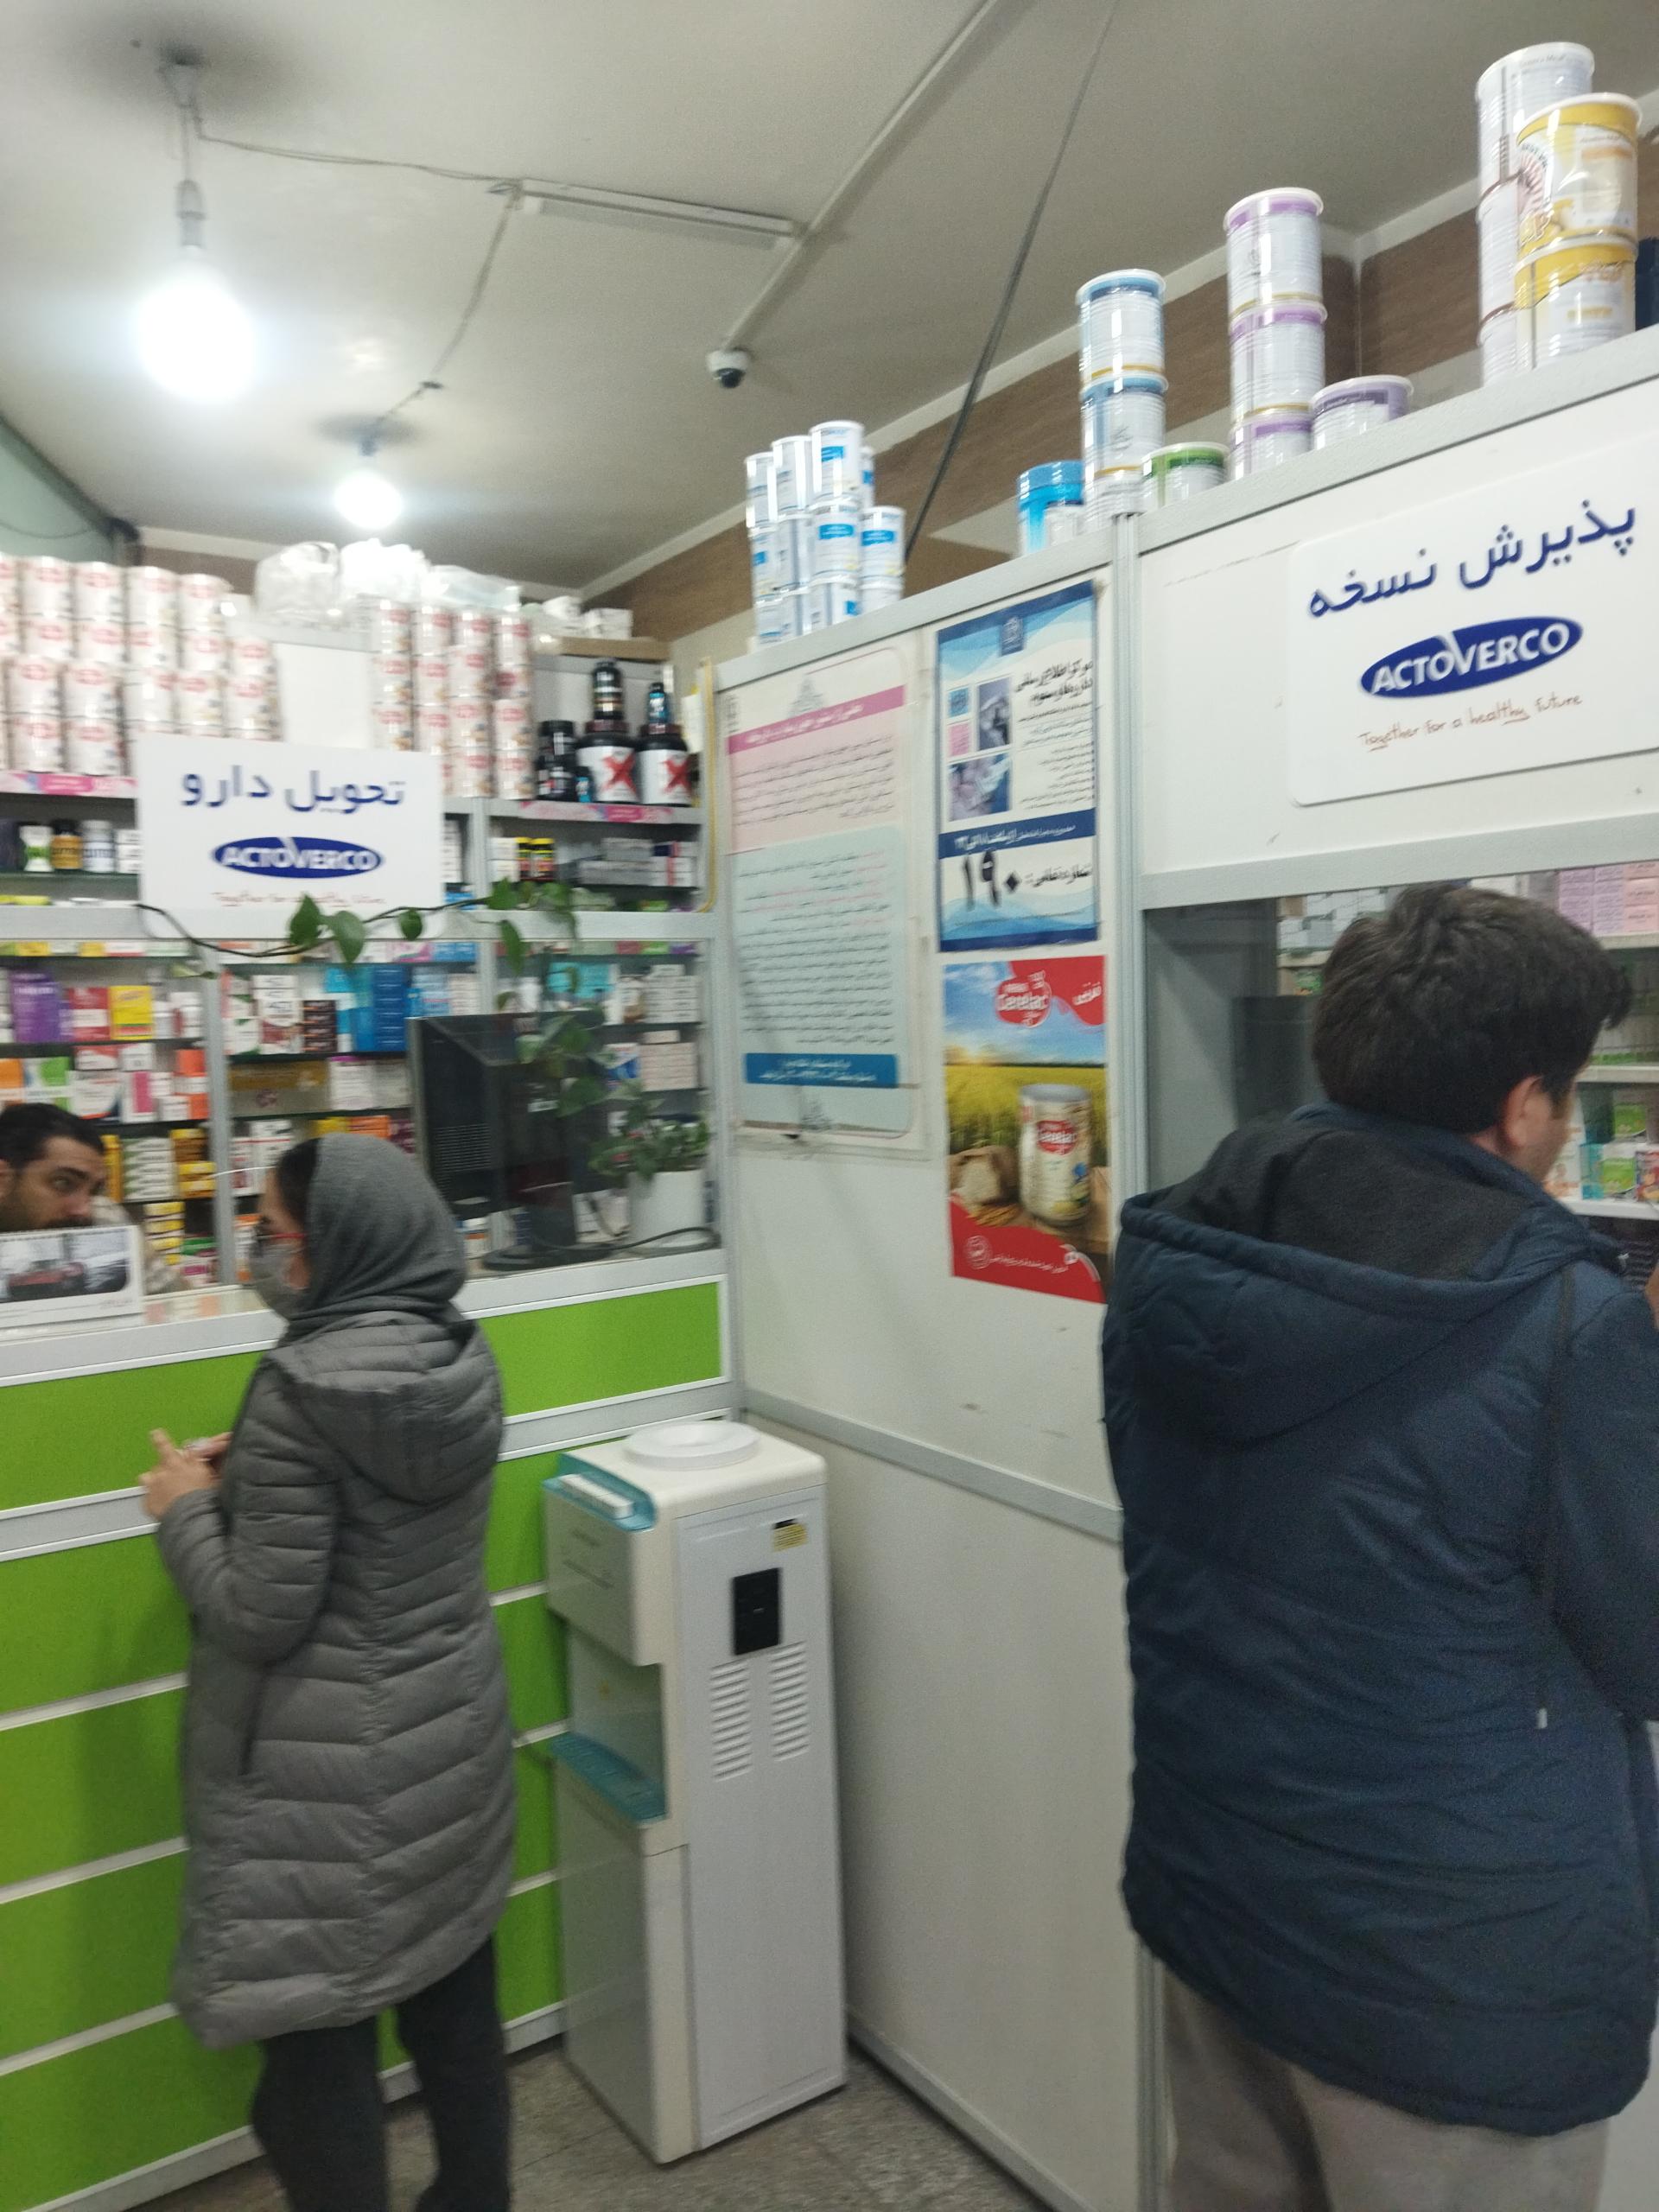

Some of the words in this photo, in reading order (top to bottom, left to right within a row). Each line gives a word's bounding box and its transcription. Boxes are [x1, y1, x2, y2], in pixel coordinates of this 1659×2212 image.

[1459, 498, 1637, 590] پذیرش
[1307, 547, 1438, 619] نسخه
[1370, 622, 1571, 696] ACTOVERCO
[180, 765, 273, 807] دارو
[284, 769, 406, 814] تحویل
[220, 841, 377, 871] ACTOVERCO
